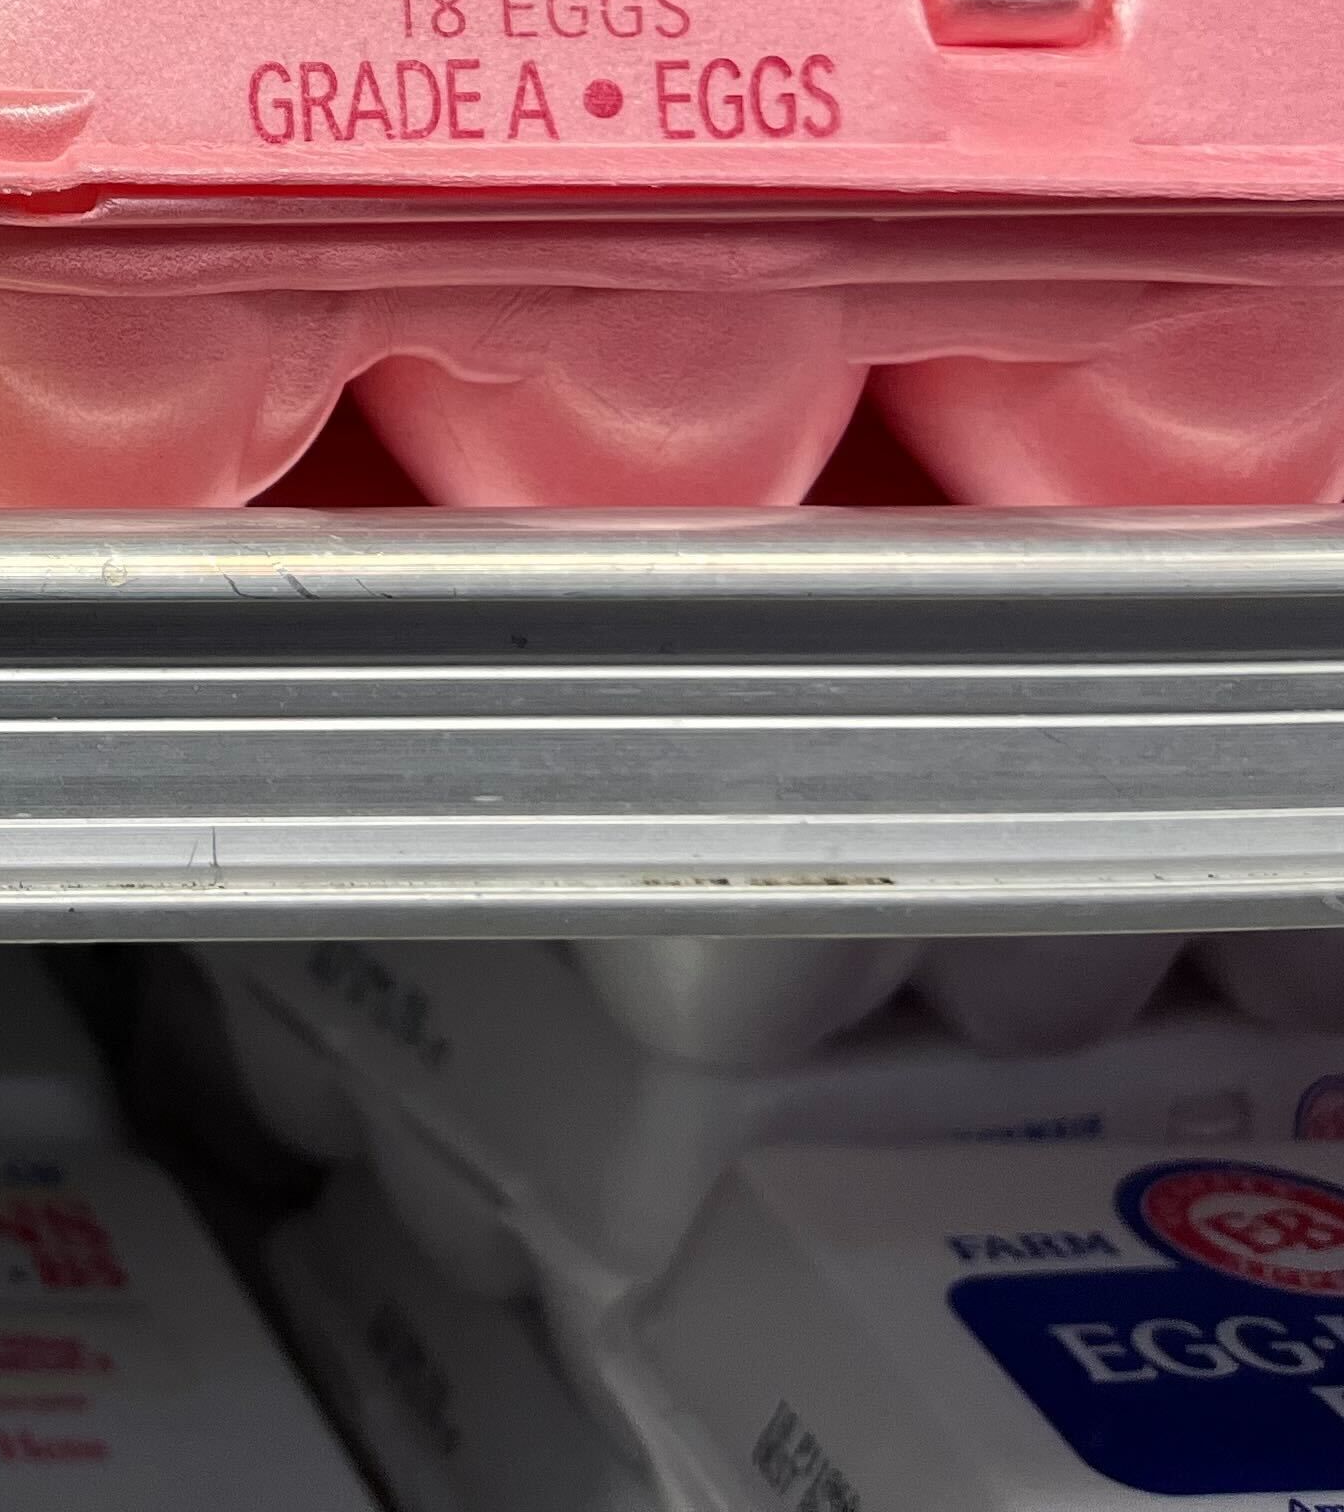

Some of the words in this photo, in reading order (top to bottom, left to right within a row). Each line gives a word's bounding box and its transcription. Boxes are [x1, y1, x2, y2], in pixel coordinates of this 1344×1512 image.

[248, 59, 485, 144] GRADE
[508, 60, 560, 140] A
[655, 55, 842, 140] EGGS
[944, 1230, 1121, 1262] FARM
